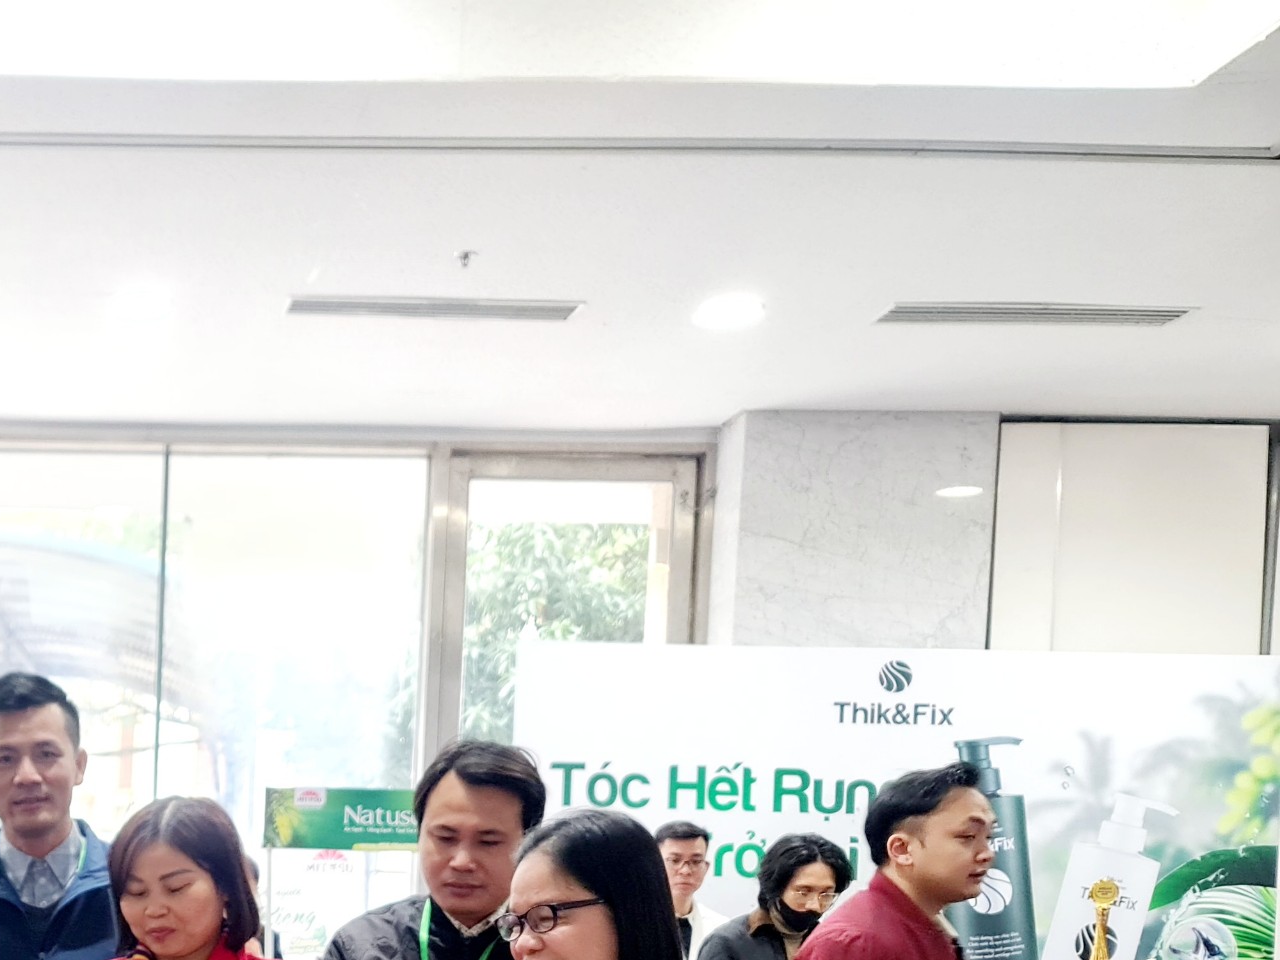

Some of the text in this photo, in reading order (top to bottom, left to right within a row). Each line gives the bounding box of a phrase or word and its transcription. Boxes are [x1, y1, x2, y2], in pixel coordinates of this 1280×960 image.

[834, 702, 954, 726] Thik&Fix
[550, 761, 892, 821] Tóc Hết Rụn
[706, 831, 765, 879] rở
